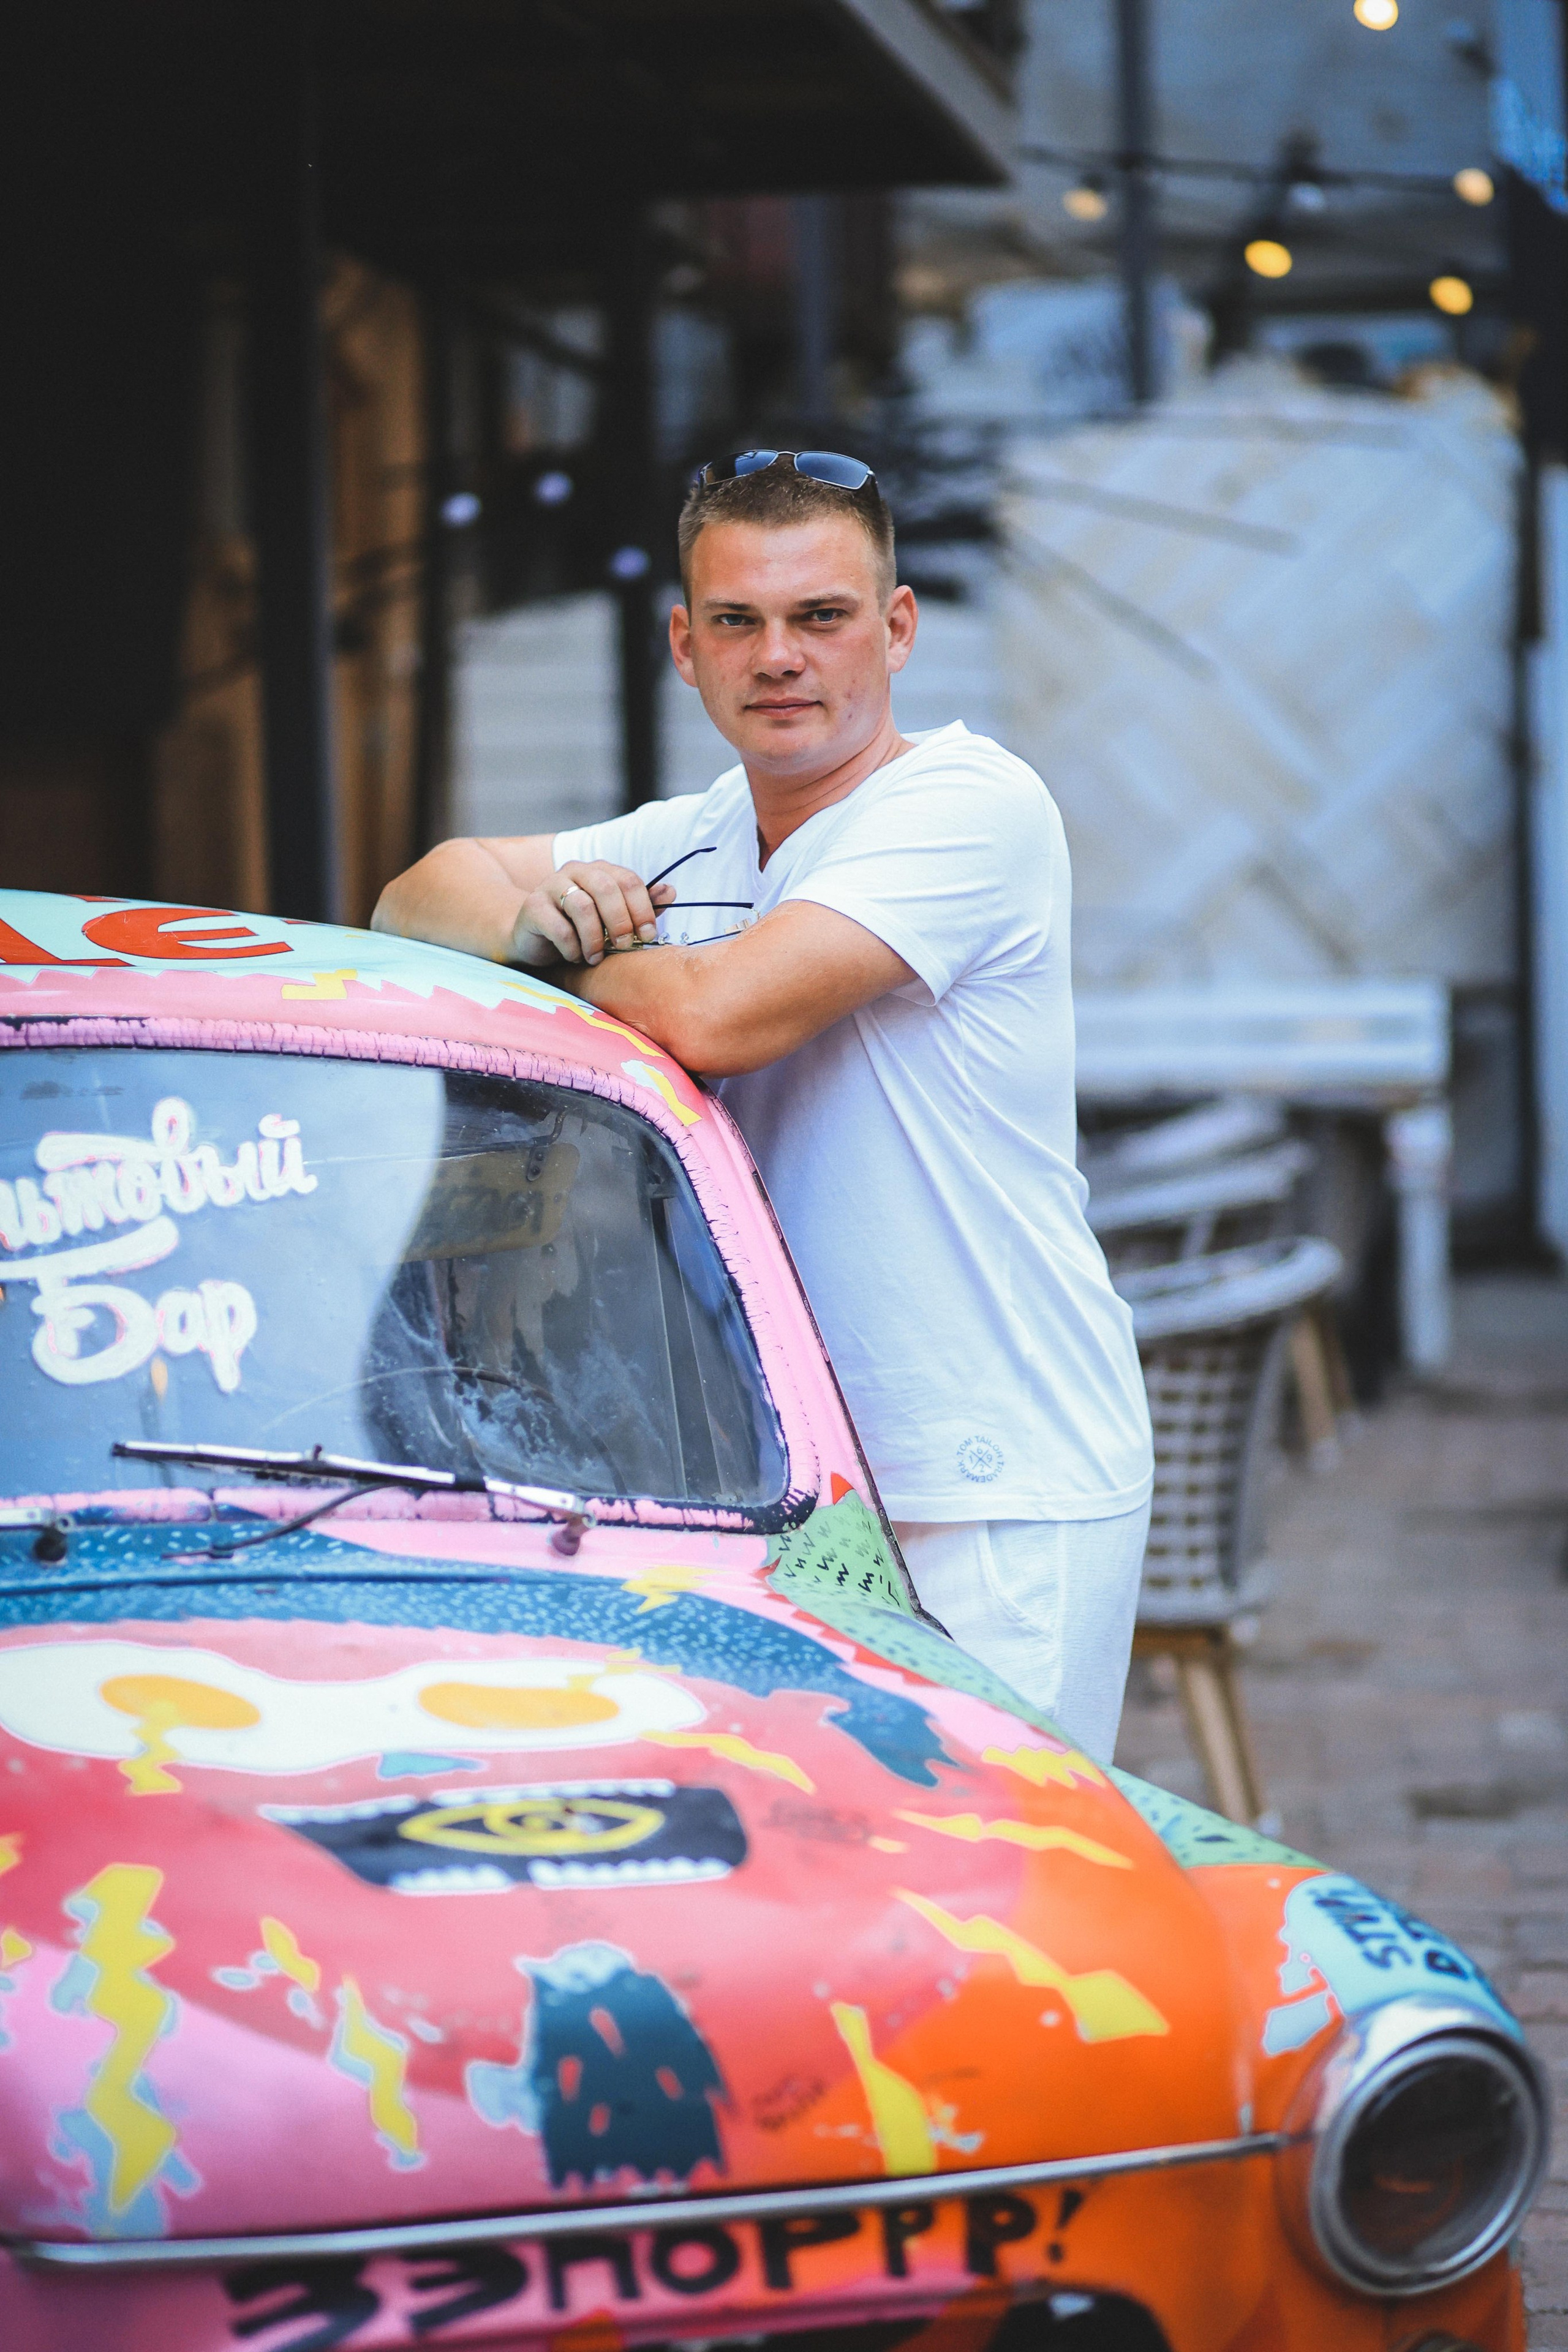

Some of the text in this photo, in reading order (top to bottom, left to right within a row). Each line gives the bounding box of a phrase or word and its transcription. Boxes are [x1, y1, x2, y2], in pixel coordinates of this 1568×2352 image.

[957, 1436, 1003, 1458] TOM TAILOR
[957, 1460, 1005, 1483] TRADEMARK
